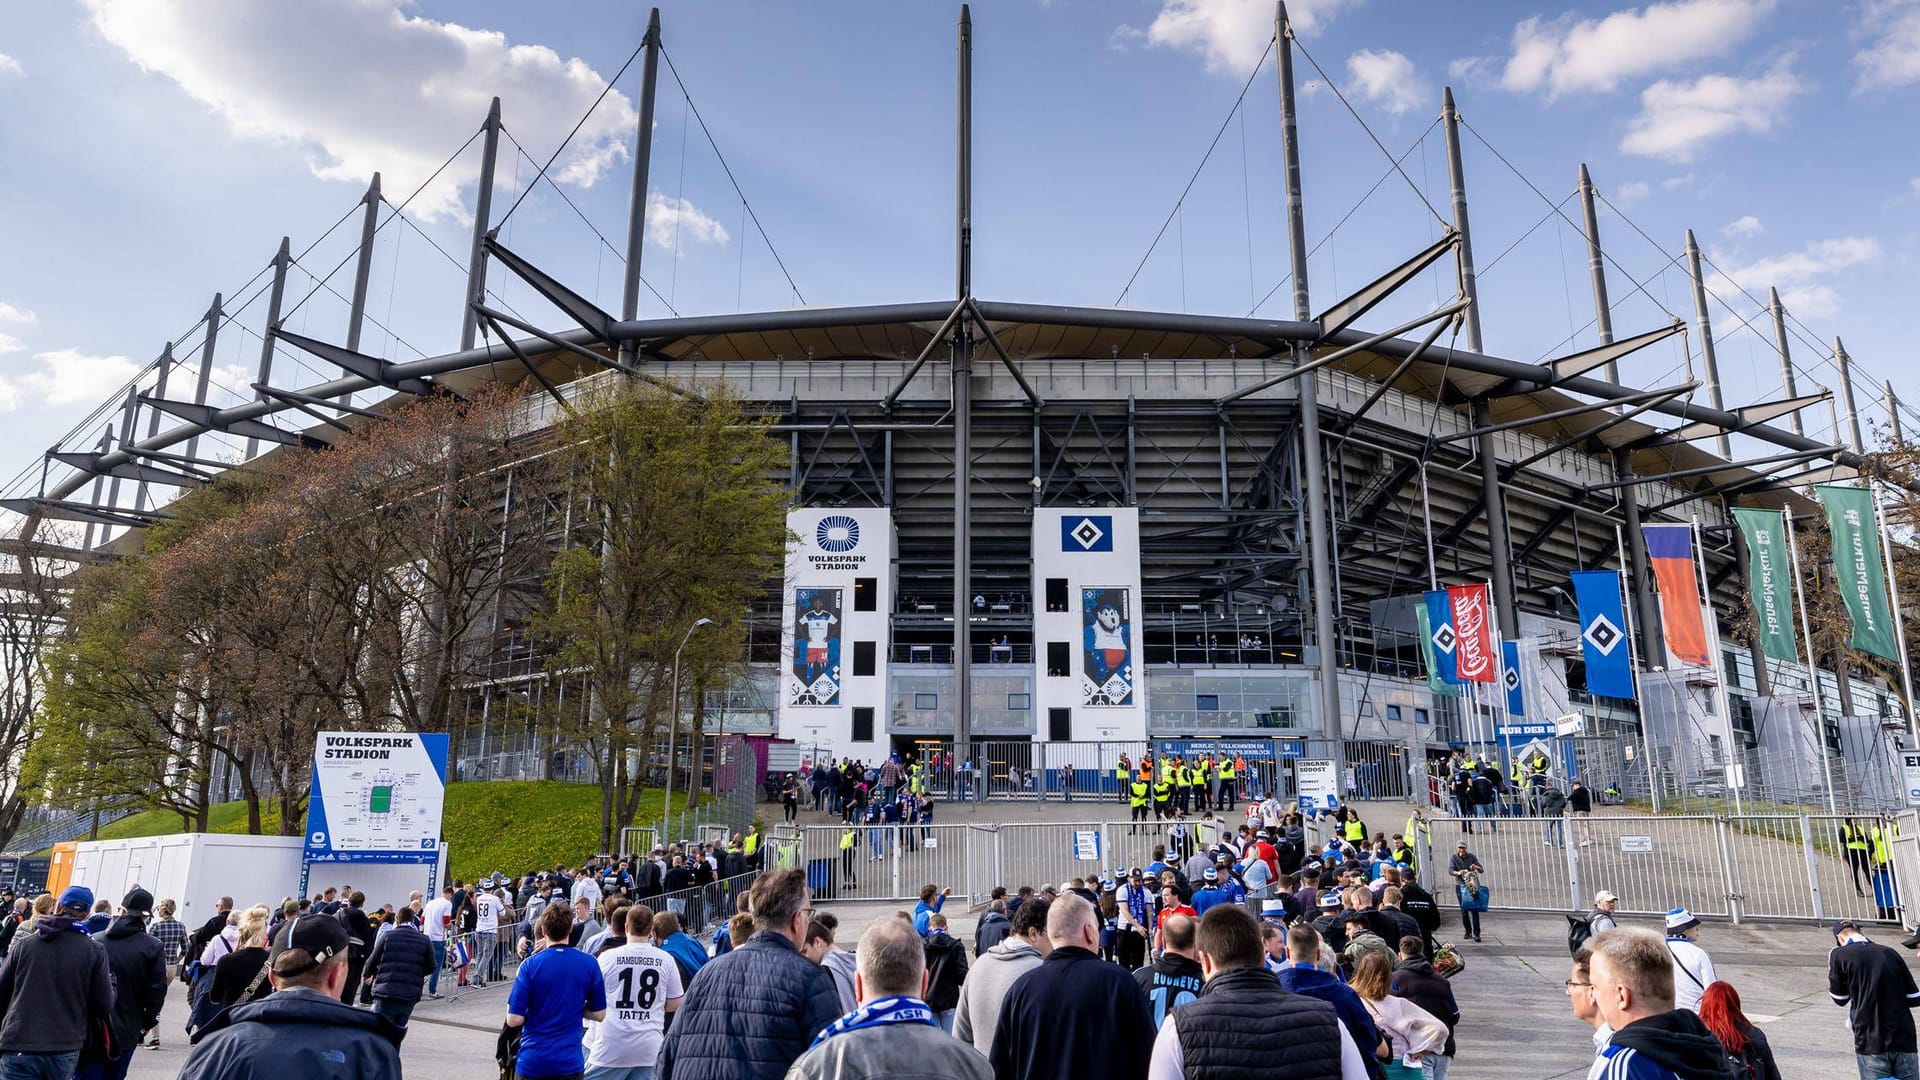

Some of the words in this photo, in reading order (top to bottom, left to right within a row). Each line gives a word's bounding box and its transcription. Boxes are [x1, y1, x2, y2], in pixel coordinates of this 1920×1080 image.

[808, 555, 867, 563] VOLKSPARK
[1498, 726, 1522, 736] NUR
[1523, 726, 1546, 735] DER
[326, 736, 413, 748] VOLKSPARK
[324, 748, 390, 760] STADION
[616, 956, 655, 966] HAMBURGER
[655, 959, 663, 967] SV
[1153, 971, 1200, 992] RUDNEVS
[615, 967, 660, 1010] 18
[619, 1010, 650, 1020] JATTA
